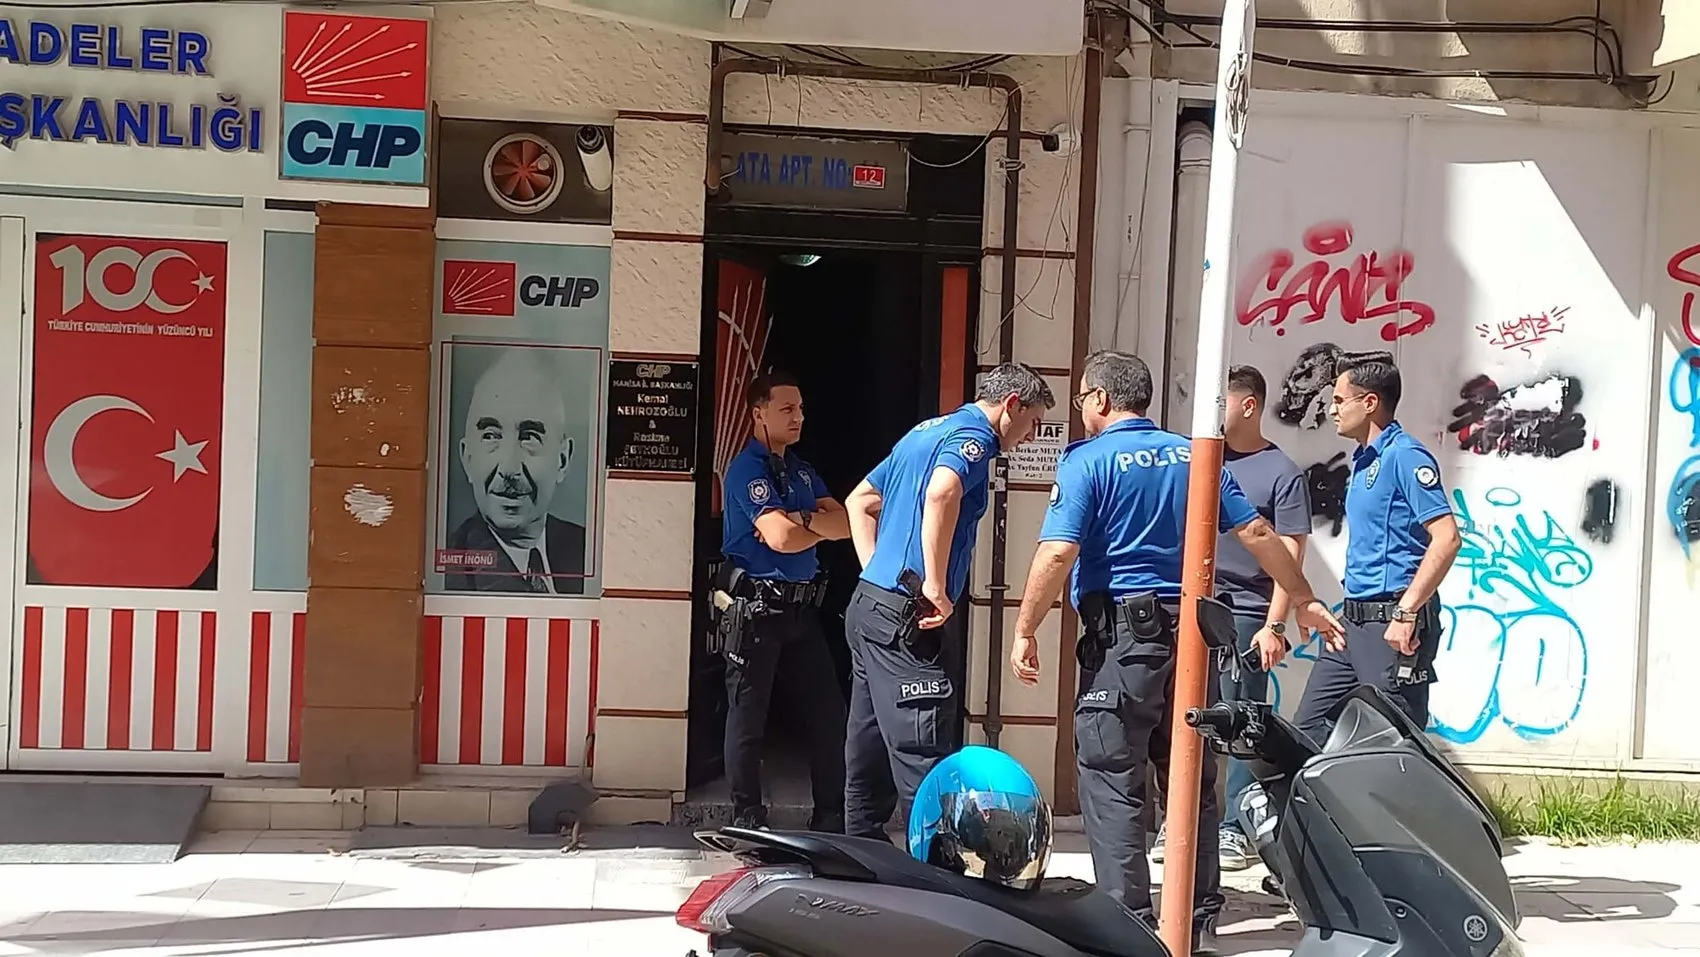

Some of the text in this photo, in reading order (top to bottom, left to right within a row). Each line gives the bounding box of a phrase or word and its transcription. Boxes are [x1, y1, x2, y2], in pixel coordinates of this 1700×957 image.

[0, 92, 262, 152] ŞKANLIĞI
[287, 119, 422, 169] CHP
[737, 152, 771, 183] ATA
[862, 169, 877, 182] 12
[519, 274, 600, 308] CHP
[48, 319, 214, 337] TÜRKİYE CUMHURİYETİNİN YÜZÜNCÜ YILI
[636, 364, 671, 378] CHP
[650, 381, 693, 391] BAŞKANLIĞI
[637, 393, 669, 404] Kemal
[617, 405, 688, 418] NEHROZOĞLU
[440, 552, 493, 565] İSMET İNÖNÜ
